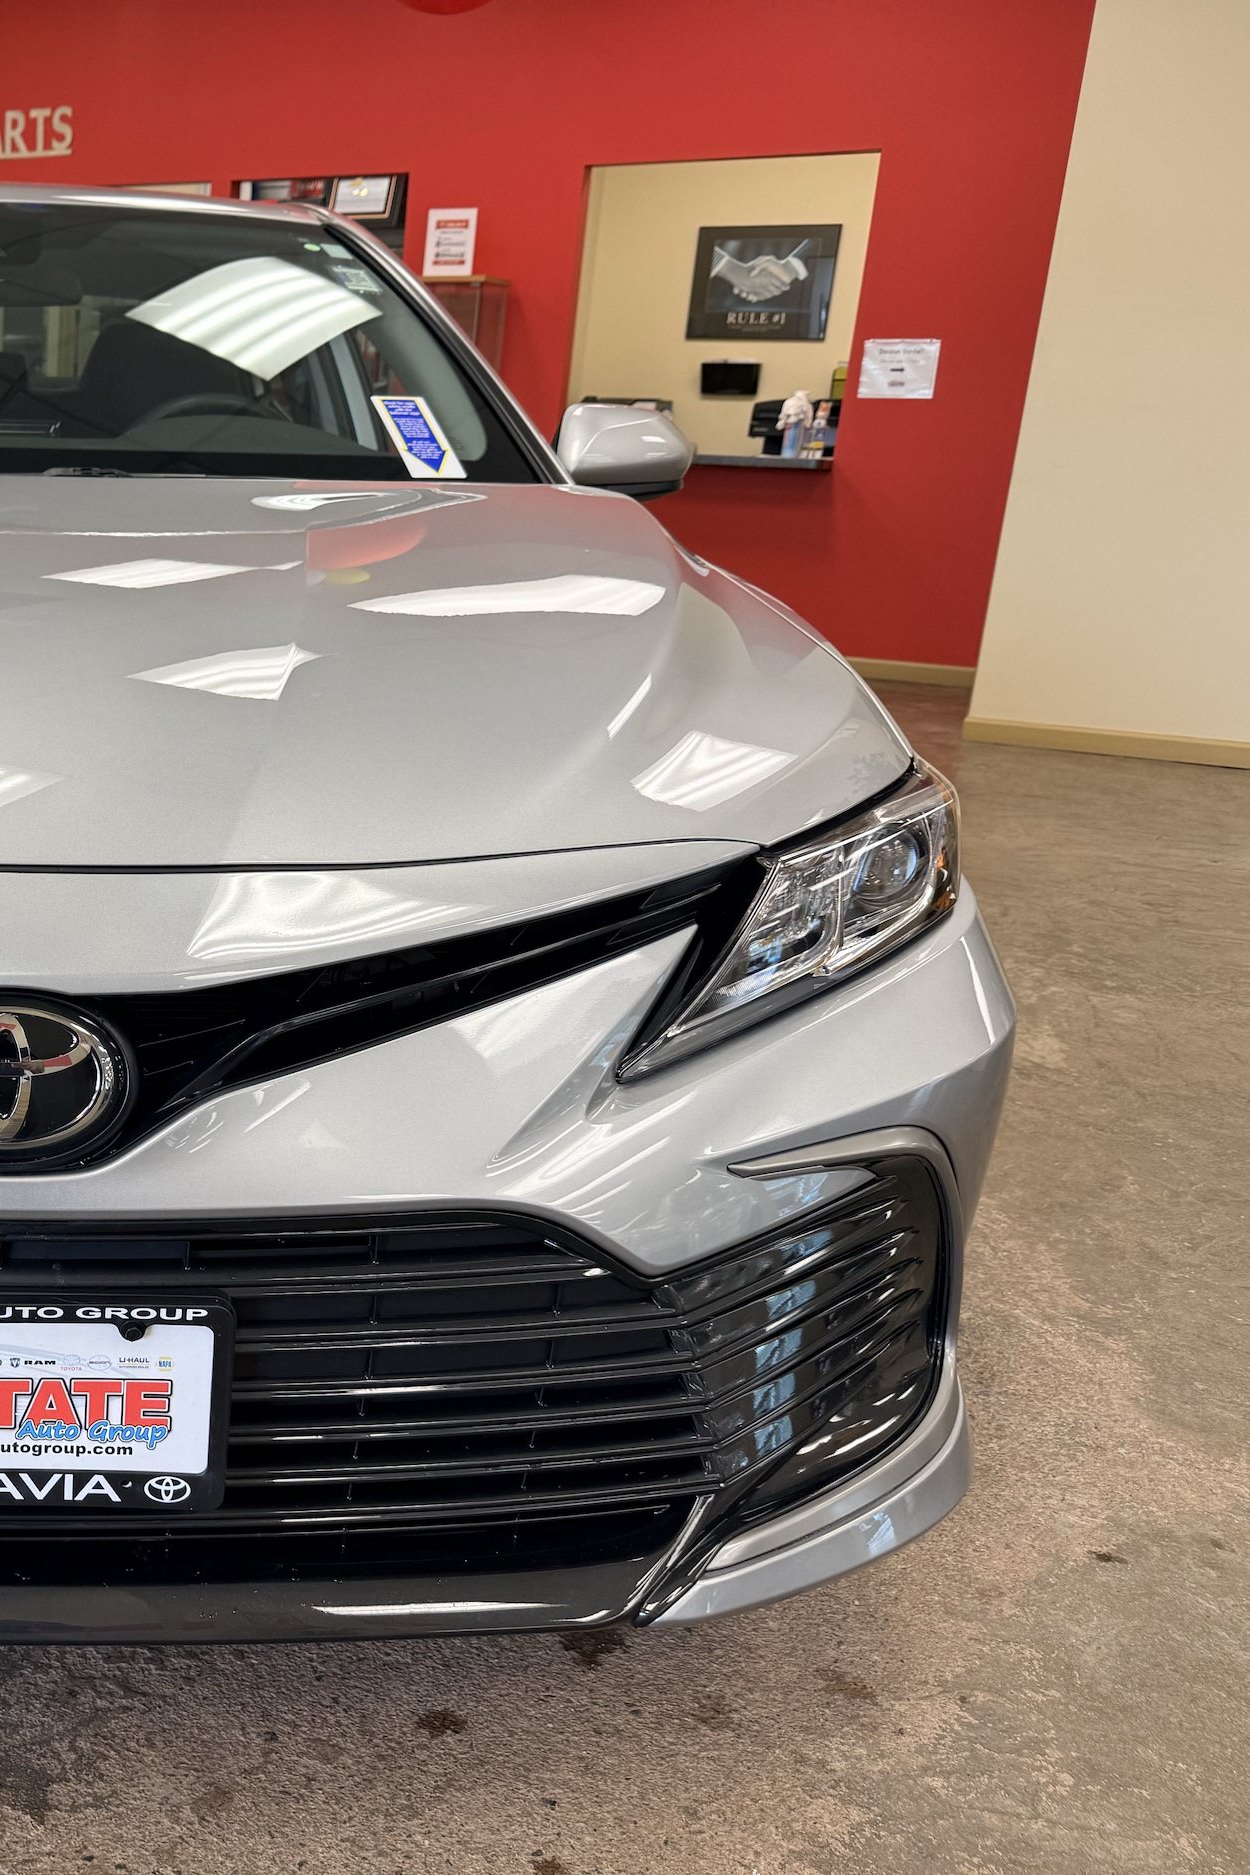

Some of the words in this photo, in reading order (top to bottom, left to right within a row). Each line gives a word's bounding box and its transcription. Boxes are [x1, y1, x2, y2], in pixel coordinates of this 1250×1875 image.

[726, 312, 769, 325] RULE
[75, 1306, 209, 1321] GROUP
[15, 1420, 81, 1441] Auto
[87, 1420, 168, 1450] Group
